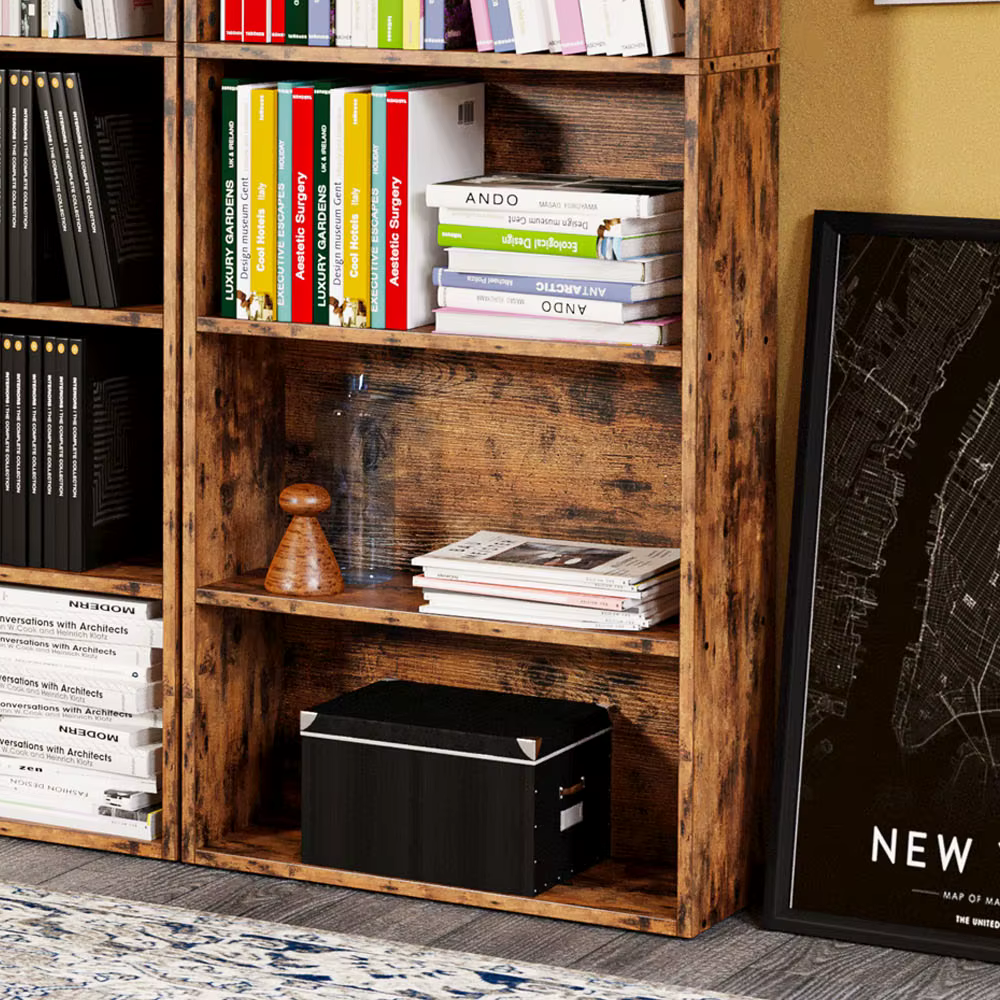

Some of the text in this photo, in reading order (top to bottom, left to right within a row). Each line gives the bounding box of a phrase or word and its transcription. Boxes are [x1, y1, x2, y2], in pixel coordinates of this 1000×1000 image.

[229, 158, 234, 168] UK
[465, 192, 518, 206] ANDO
[225, 180, 234, 244] GARDENS
[241, 177, 251, 280] Design museum Gent
[256, 182, 266, 272] Cool Hotels Italy
[296, 172, 308, 280] Aestetic Surgery
[389, 177, 402, 286] Aestetic Surgery
[508, 216, 588, 230] Design museum Gent
[318, 185, 327, 307] LUXURY GARDENS
[502, 234, 578, 253] Ecological Design
[225, 249, 234, 300] LUXURY
[536, 281, 607, 297] ANTARCTIC
[541, 300, 587, 315] ANDO
[69, 600, 135, 615] MODERN
[57, 619, 77, 630] with
[80, 622, 128, 635] Architects
[52, 643, 70, 651] with
[72, 645, 116, 656] Architects
[41, 680, 59, 691] with
[60, 684, 103, 699] Architects
[59, 725, 119, 743] MODERN
[46, 743, 64, 755] with
[67, 747, 112, 762] Architects
[10, 778, 88, 797] FASHION DESIGN
[872, 825, 973, 874] NEW
[943, 891, 981, 903] MAP OF
[956, 915, 969, 925] THE
